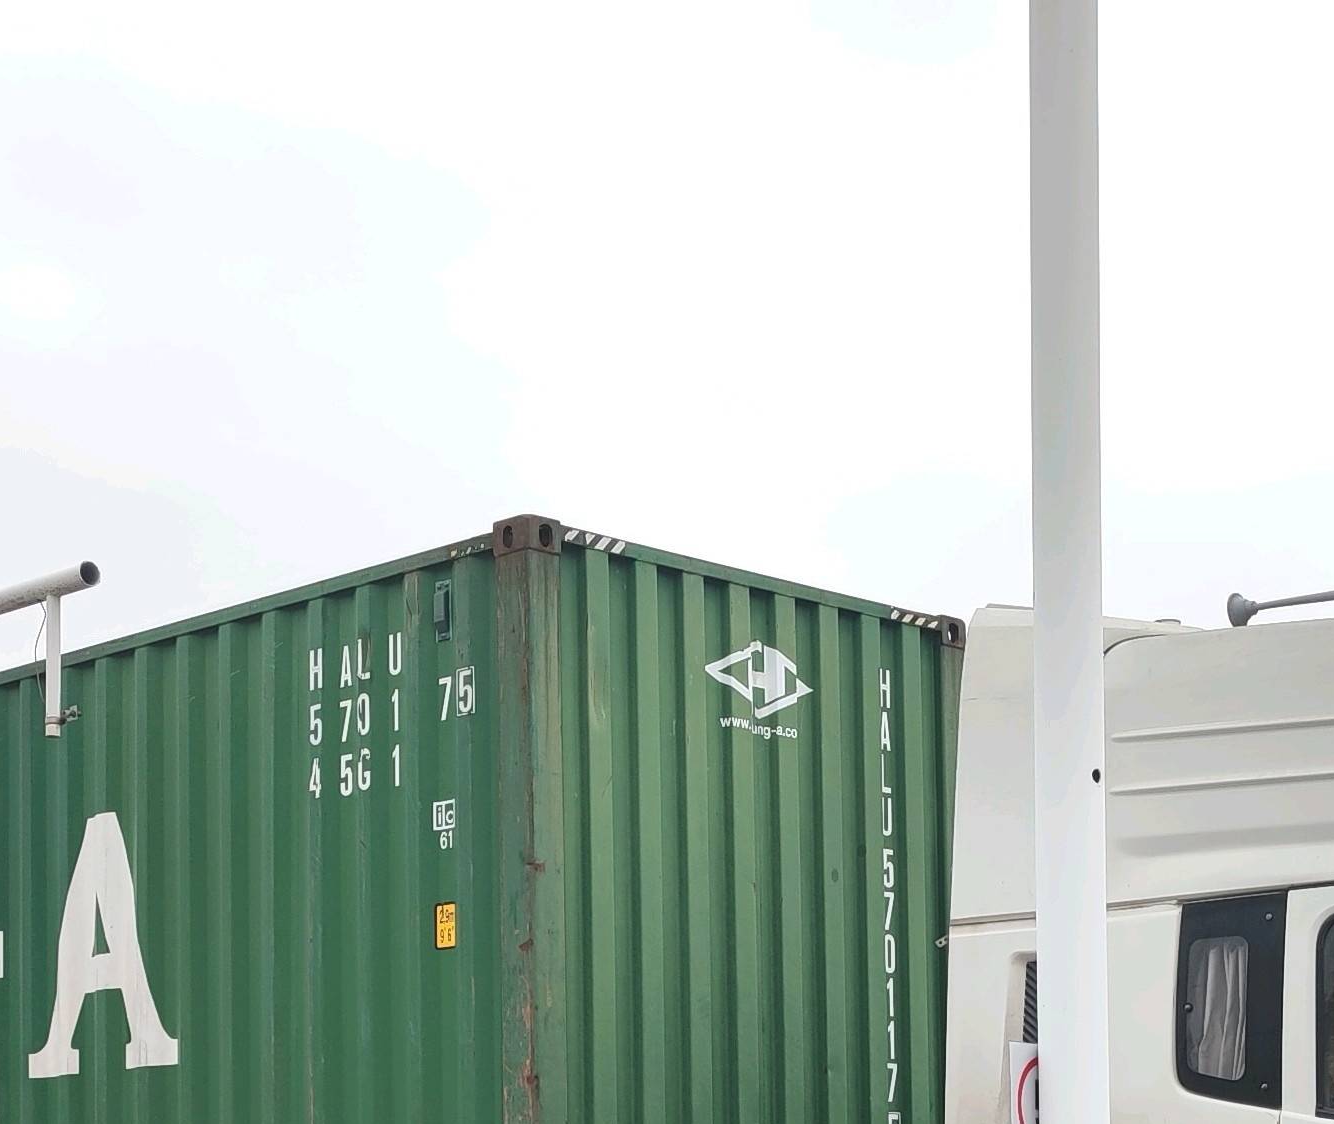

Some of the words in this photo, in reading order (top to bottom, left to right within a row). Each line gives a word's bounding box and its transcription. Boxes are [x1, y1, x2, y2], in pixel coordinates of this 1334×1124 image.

[309, 632, 402, 691] HALU
[309, 689, 399, 746] 5701
[309, 744, 400, 798] 45G1
[440, 831, 453, 850] 61
